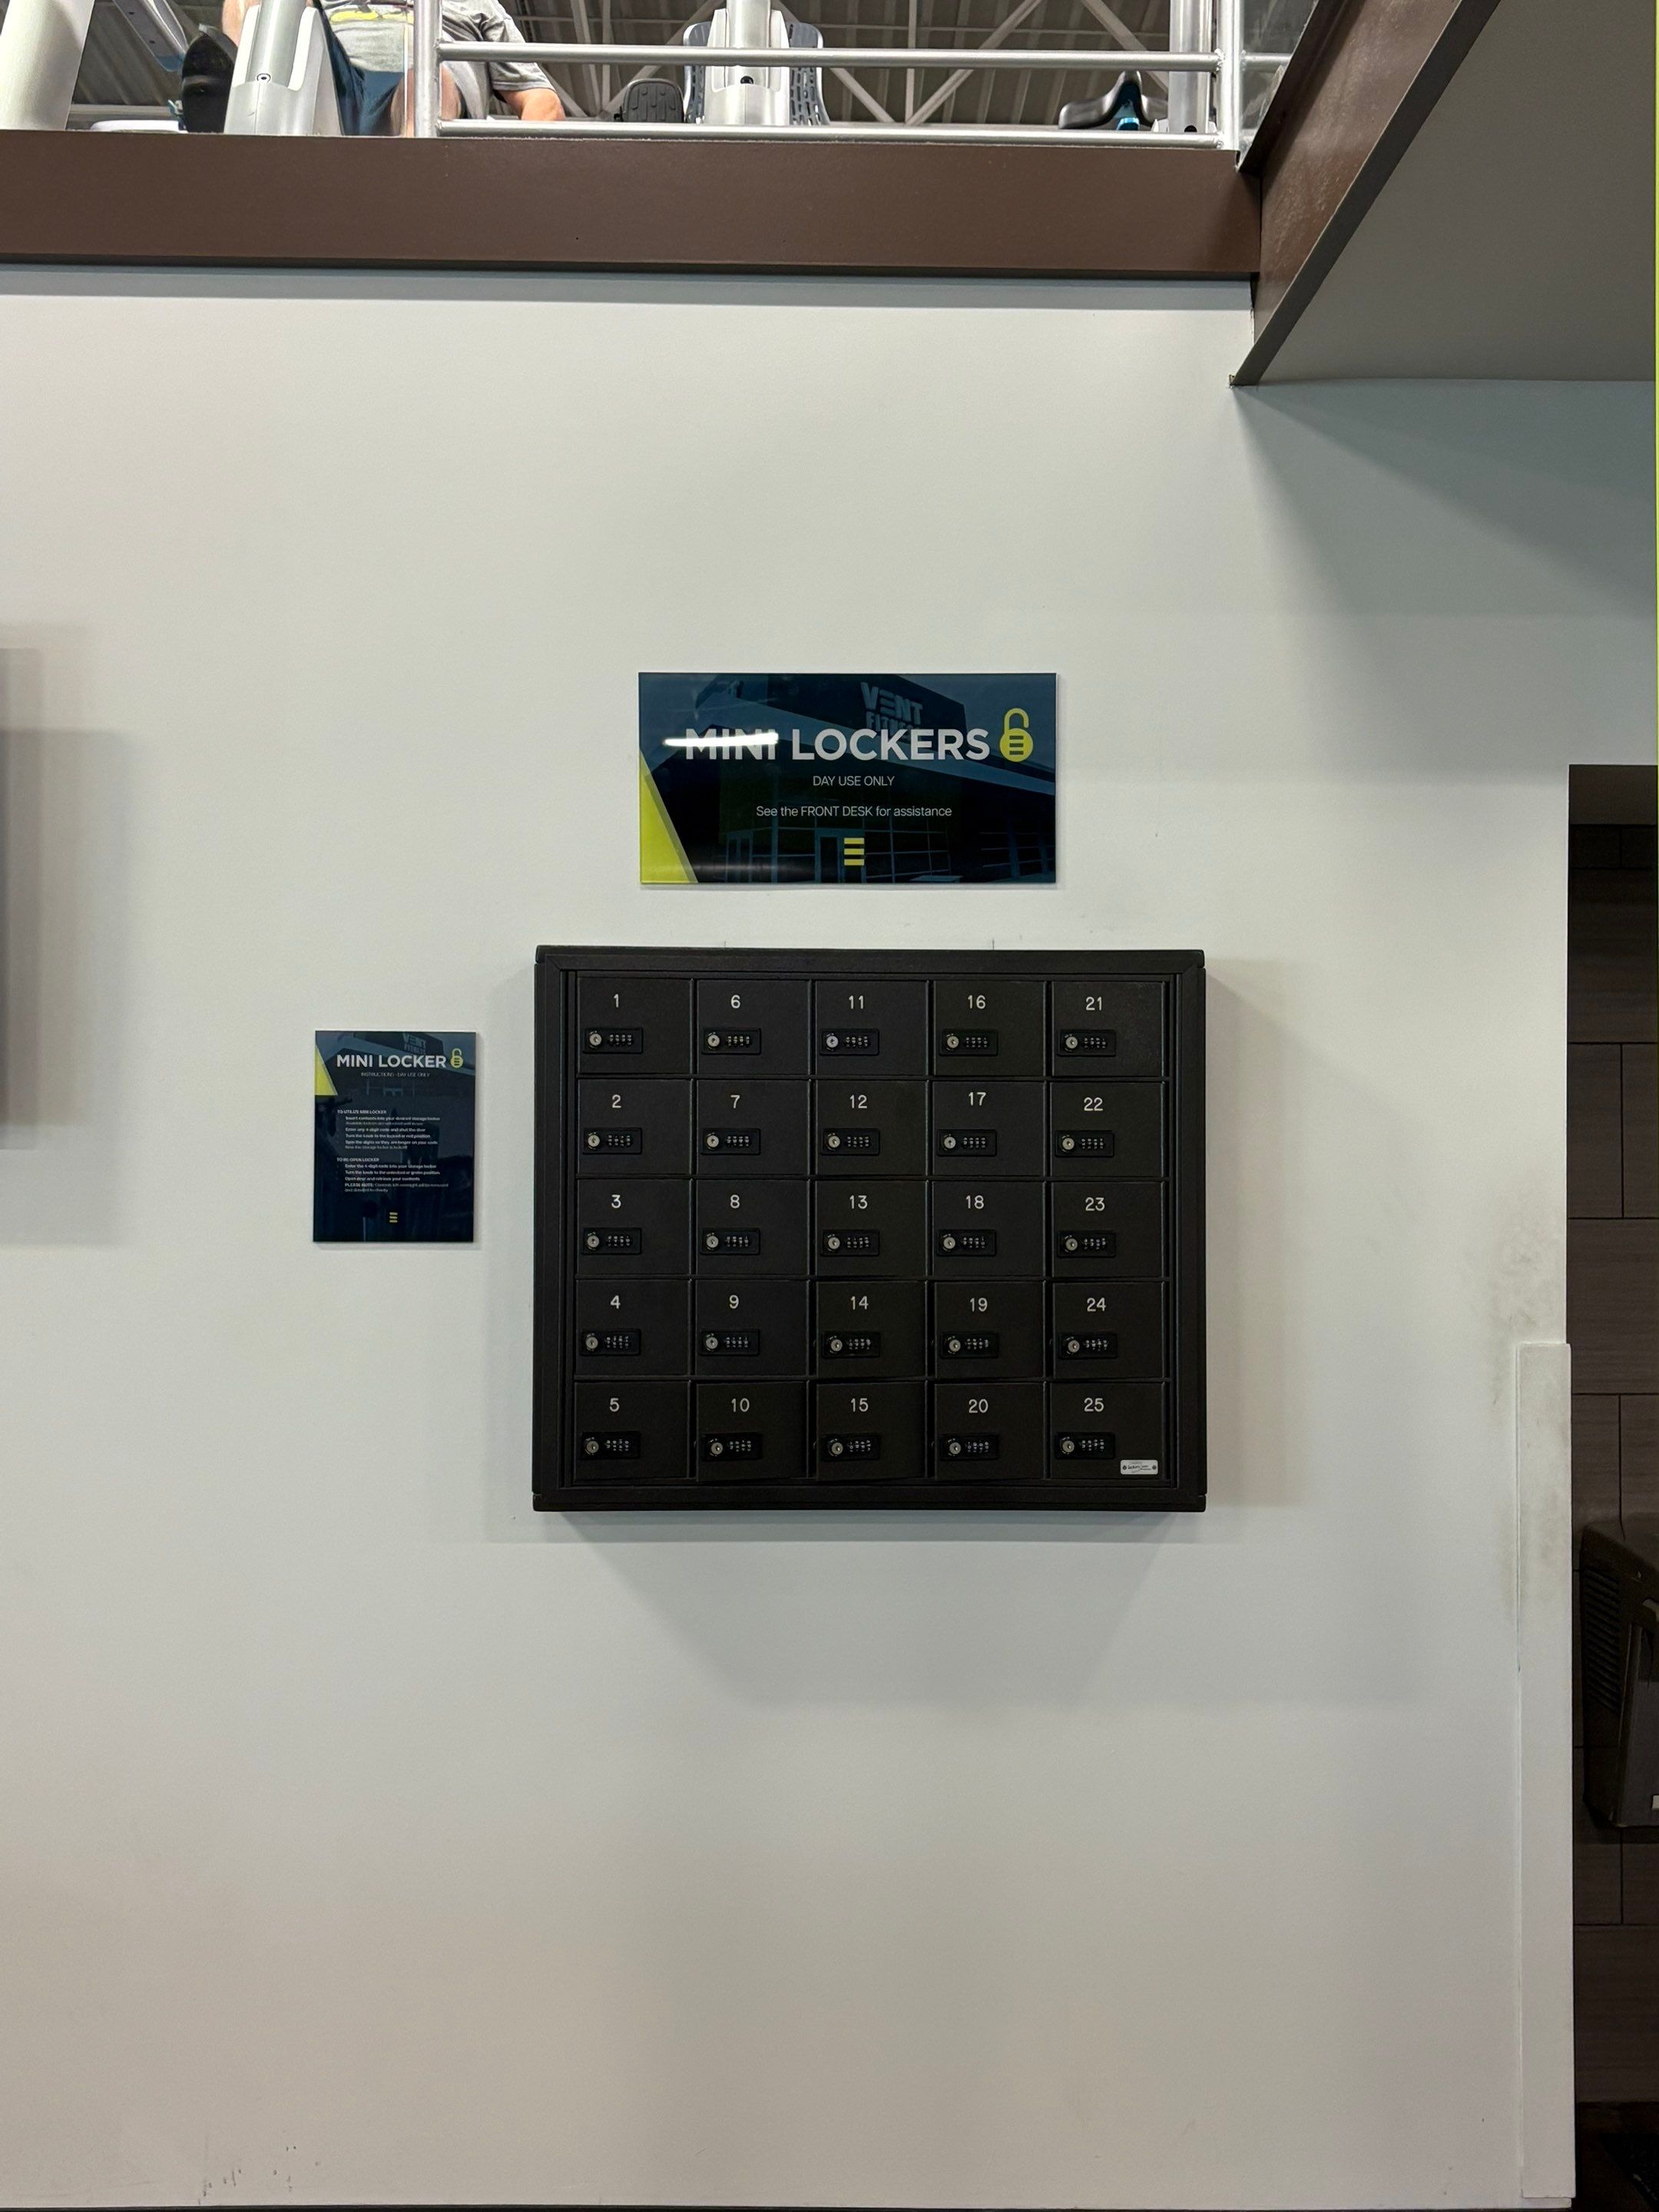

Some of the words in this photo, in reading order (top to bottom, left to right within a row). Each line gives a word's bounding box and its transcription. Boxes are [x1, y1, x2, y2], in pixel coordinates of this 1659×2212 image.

[685, 729, 777, 760] MINI
[792, 727, 989, 761] LOCKERS
[813, 775, 836, 786] DAY
[839, 775, 861, 786] USE
[863, 775, 896, 786] ONLY
[756, 805, 778, 817] See
[780, 805, 798, 817] the
[800, 805, 839, 817] FRONT
[842, 805, 873, 817] DESK
[875, 805, 891, 817] for
[892, 805, 952, 817] assistance
[613, 993, 619, 1008] 1
[730, 994, 741, 1009] 6
[848, 995, 864, 1009] 11
[967, 995, 986, 1009] 16
[1085, 996, 1102, 1011] 21
[336, 1055, 373, 1068] MINI
[379, 1055, 447, 1068] LOCKER
[611, 1094, 622, 1108] 2
[730, 1094, 740, 1109] 7
[849, 1094, 868, 1109] 12
[968, 1091, 987, 1106] 17
[1083, 1097, 1104, 1111] 22
[611, 1194, 621, 1209] 3
[730, 1194, 740, 1209] 8
[849, 1194, 868, 1210] 13
[965, 1194, 985, 1210] 18
[1084, 1197, 1105, 1212] 23
[610, 1295, 621, 1310] 4
[729, 1294, 740, 1310] 9
[850, 1295, 869, 1310] 14
[969, 1297, 988, 1312] 19
[1087, 1297, 1107, 1312] 24
[609, 1397, 620, 1412] 5
[731, 1398, 750, 1412] 10
[850, 1397, 869, 1412] 15
[969, 1399, 988, 1414] 20
[1084, 1397, 1104, 1412] 25
